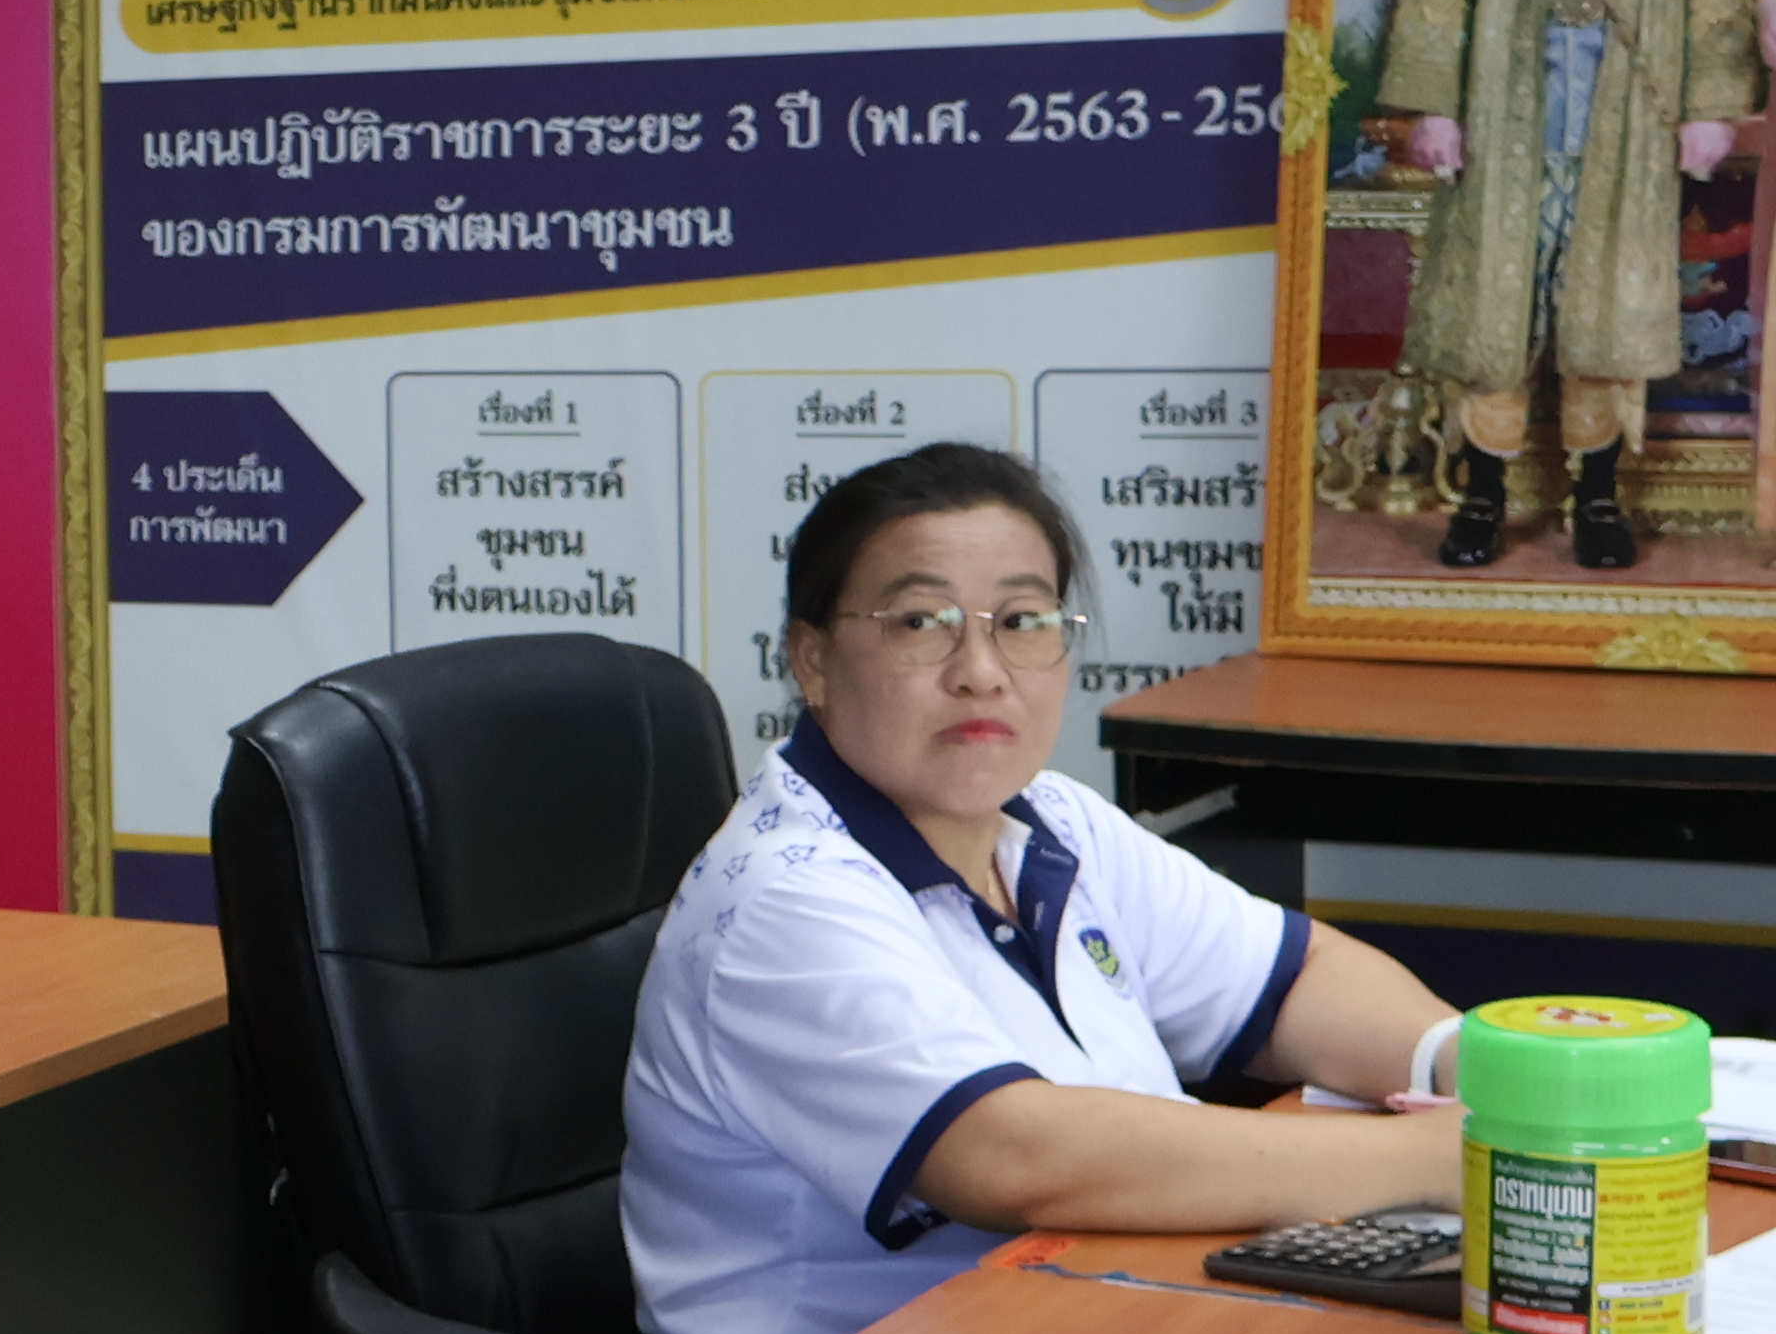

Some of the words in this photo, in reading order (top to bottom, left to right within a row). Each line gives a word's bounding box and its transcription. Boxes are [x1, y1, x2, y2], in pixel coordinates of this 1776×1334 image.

[143, 107, 704, 179] แผนปฏิบัติราชการระยะ
[725, 104, 759, 153] 3
[774, 89, 823, 151] ปี
[848, 93, 982, 157] (พ.ศ.
[1005, 88, 1149, 143] 2563
[1162, 109, 1183, 124] -
[141, 195, 734, 273] ของกรมการพัฒนาชุมชน
[478, 391, 554, 425] เรื่องที่
[565, 400, 577, 425] 1
[796, 389, 878, 426] เรื่องที่
[888, 400, 906, 426] 2
[1138, 388, 1228, 426] เรื่องที่
[1239, 398, 1258, 427] 3
[130, 462, 153, 493] 4
[162, 452, 285, 494] ประเด็น
[435, 457, 626, 500] สร้างสรรค์
[129, 506, 289, 545] การพัฒนา
[476, 526, 584, 571] ชุมชน
[428, 564, 638, 617] พึ่งตนเองได้
[1159, 580, 1244, 634] ให้มี
